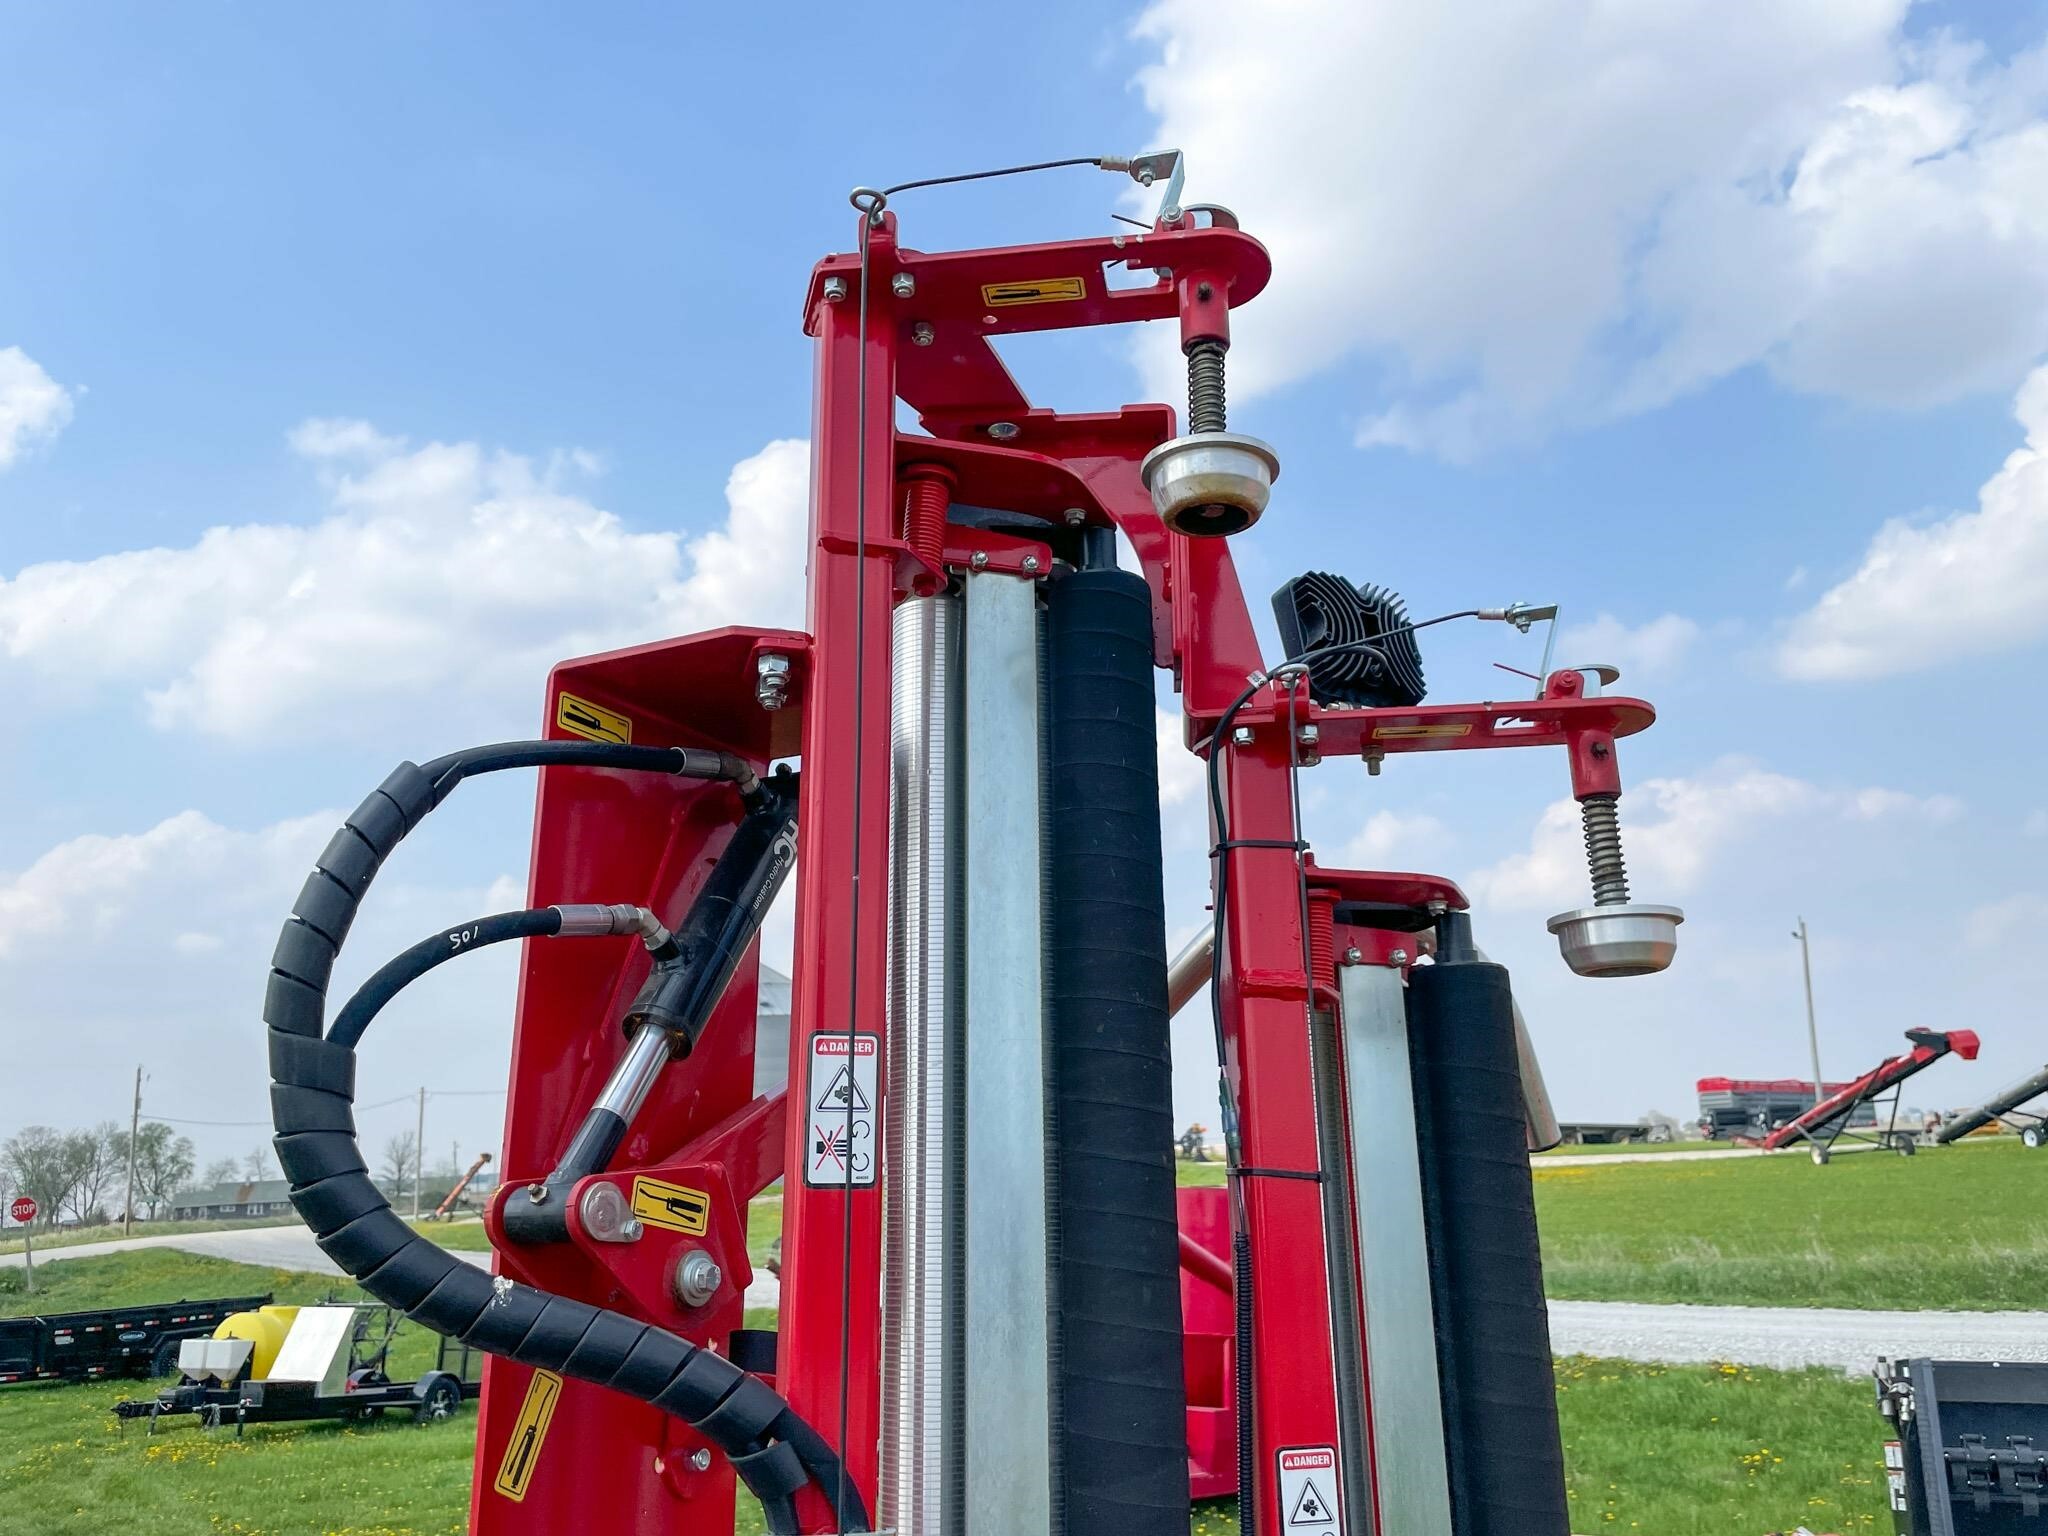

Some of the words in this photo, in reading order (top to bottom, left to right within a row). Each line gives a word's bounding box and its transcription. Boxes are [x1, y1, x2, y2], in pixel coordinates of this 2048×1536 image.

[769, 856, 785, 880] Hydro
[753, 880, 773, 910] Custom
[829, 1042, 872, 1053] DANGER
[12, 1203, 35, 1216] STOP
[1293, 1454, 1330, 1466] DANGER
